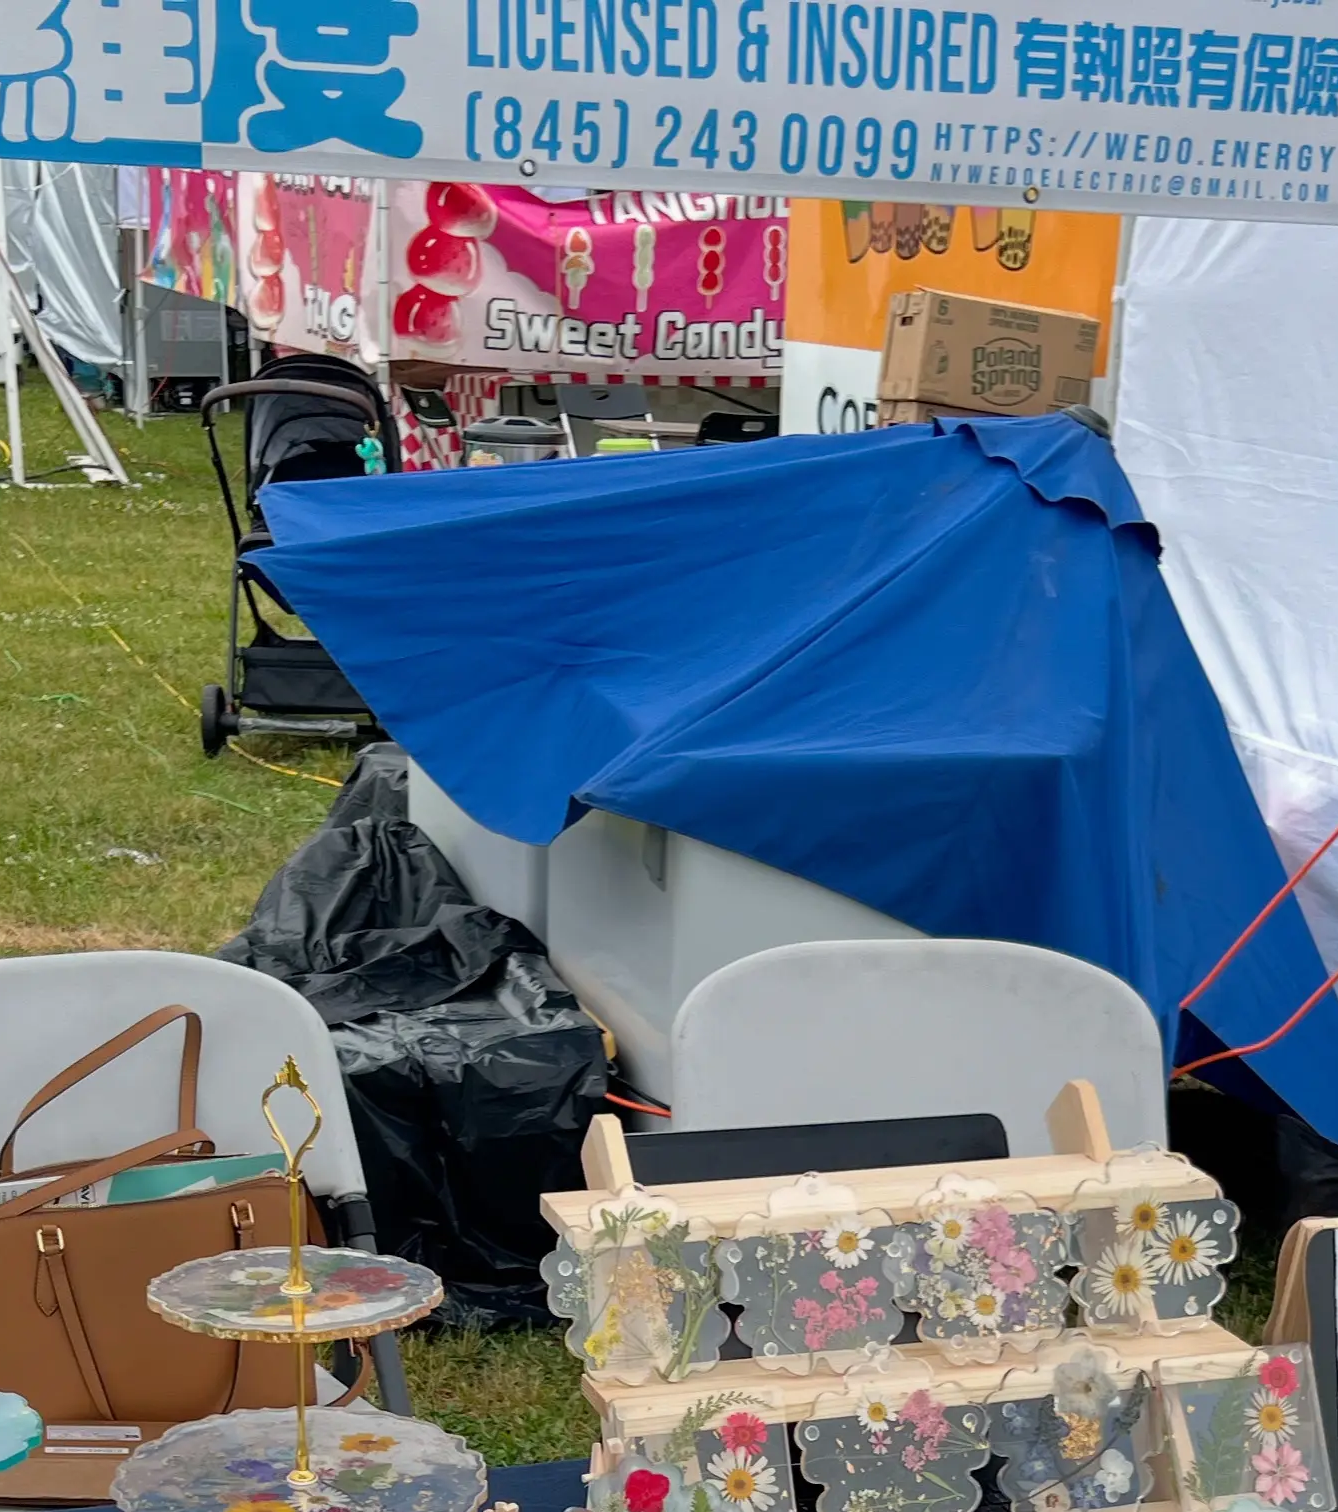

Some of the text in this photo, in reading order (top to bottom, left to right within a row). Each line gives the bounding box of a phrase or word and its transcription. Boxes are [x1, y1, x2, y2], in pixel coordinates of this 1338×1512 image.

[466, 0, 717, 79] LICENSED
[738, 0, 769, 83] &
[787, 1, 998, 96] INSURED
[465, 90, 919, 180] (845) 243 0099
[933, 122, 1336, 174] HTTPS://WEDO.ENERGY
[929, 162, 1331, 203] NYWEDOELECTRIC@GMAIL.COM
[483, 297, 786, 369] Sweet Candy
[973, 345, 1042, 372] Poland
[971, 369, 1040, 395] Spring
